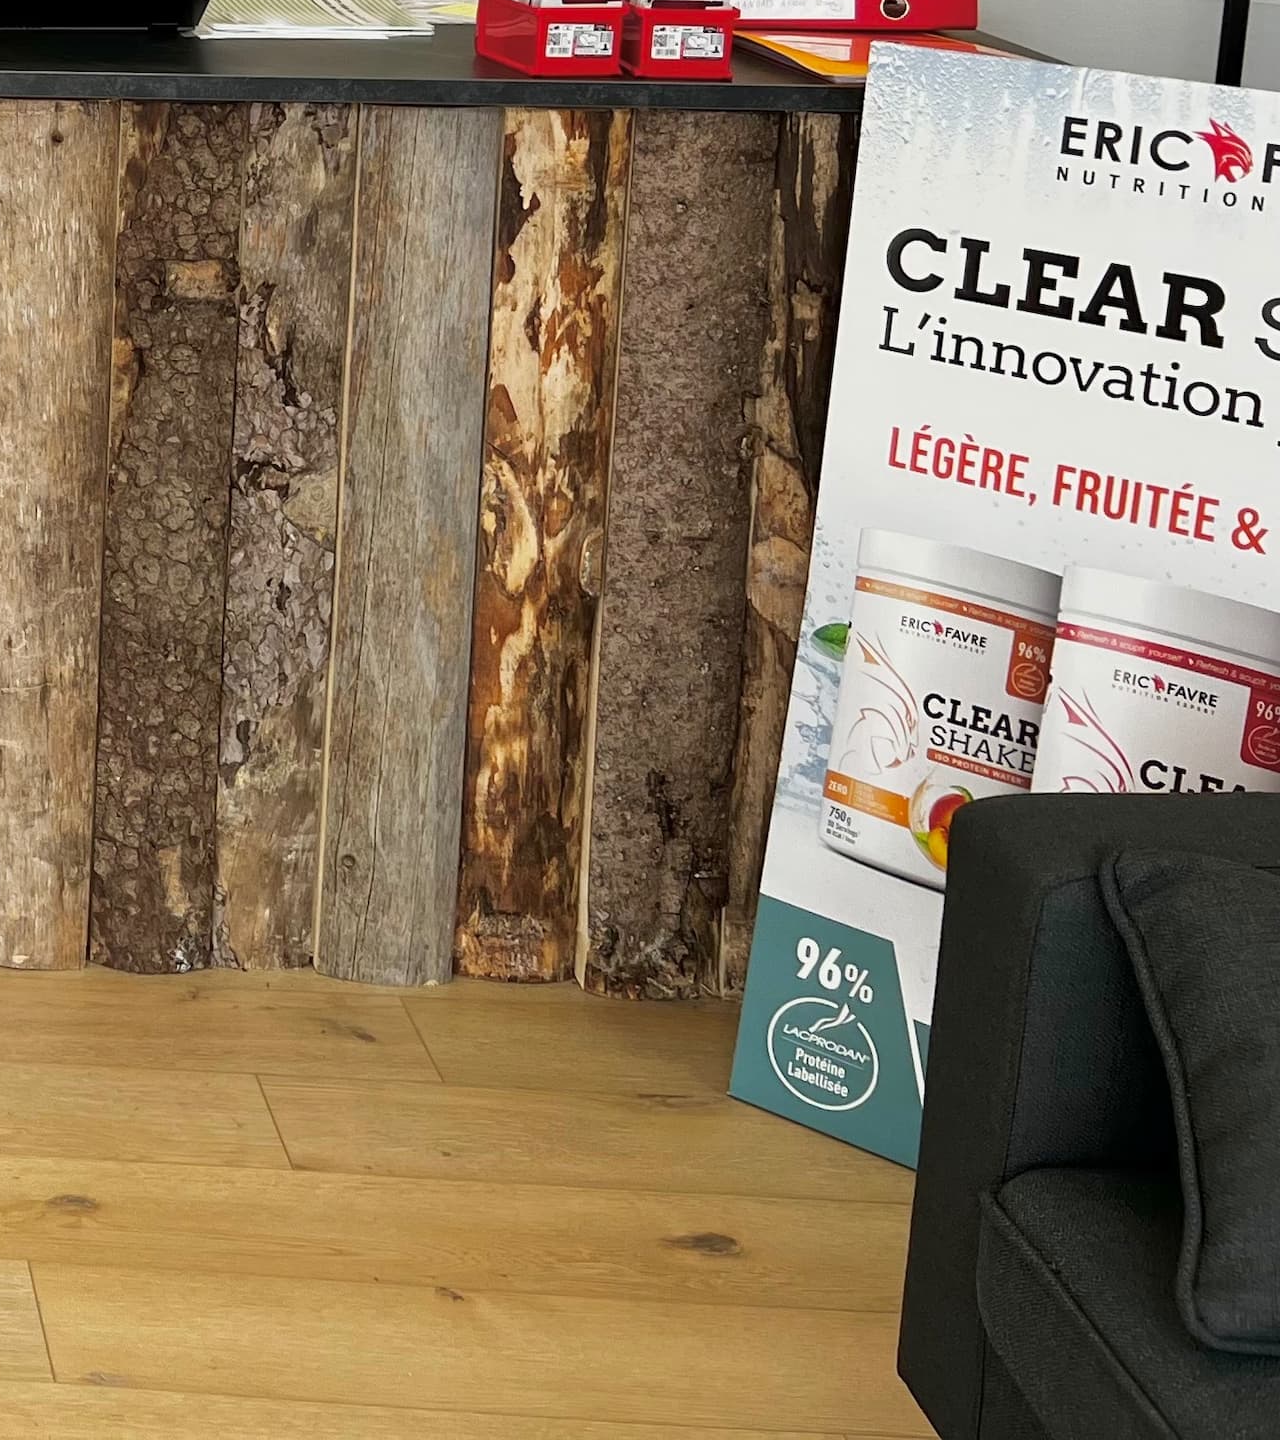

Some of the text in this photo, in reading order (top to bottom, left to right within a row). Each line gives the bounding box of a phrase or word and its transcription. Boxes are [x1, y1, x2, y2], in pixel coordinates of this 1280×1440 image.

[1059, 116, 1195, 172] ERIC
[1056, 166, 1264, 212] NUTRITION
[886, 228, 1226, 349] CLEAR
[887, 424, 1269, 555] LÉGÈRE, FRUITÉE &
[901, 616, 988, 648] ERIC FAVRE
[1018, 642, 1046, 663] 96%
[1076, 630, 1109, 644] Refresh
[1148, 647, 1184, 664] yourself
[1195, 659, 1229, 675] Refresh
[1112, 683, 1216, 716] NUTRITION EXPERT
[1113, 668, 1219, 708] ERIC FAVRE
[923, 693, 1040, 749] CLEAR
[929, 725, 1037, 774] SHAKE
[934, 752, 1024, 785] ISO PROTEIN WATER
[827, 779, 848, 796] ZERO
[796, 937, 873, 1003] 96%
[787, 1061, 849, 1098] Labellisée
[795, 1046, 846, 1079] Protéine
